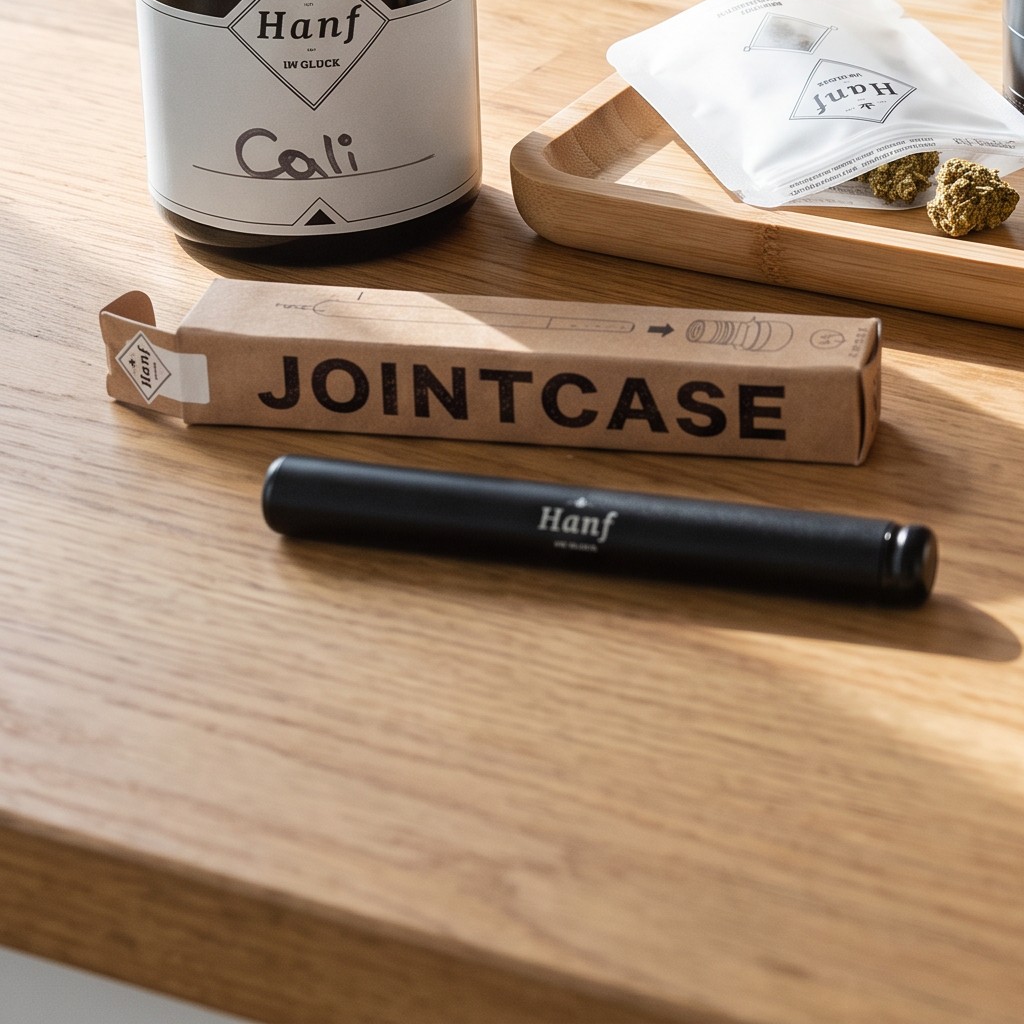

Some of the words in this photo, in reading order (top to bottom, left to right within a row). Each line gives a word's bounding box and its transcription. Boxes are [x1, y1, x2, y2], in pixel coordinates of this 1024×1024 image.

[256, 3, 363, 45] Hanf
[812, 82, 899, 116] Hanf
[235, 127, 359, 180] Cali
[257, 355, 787, 442] JOINTCASE
[537, 505, 619, 544] Hanf
